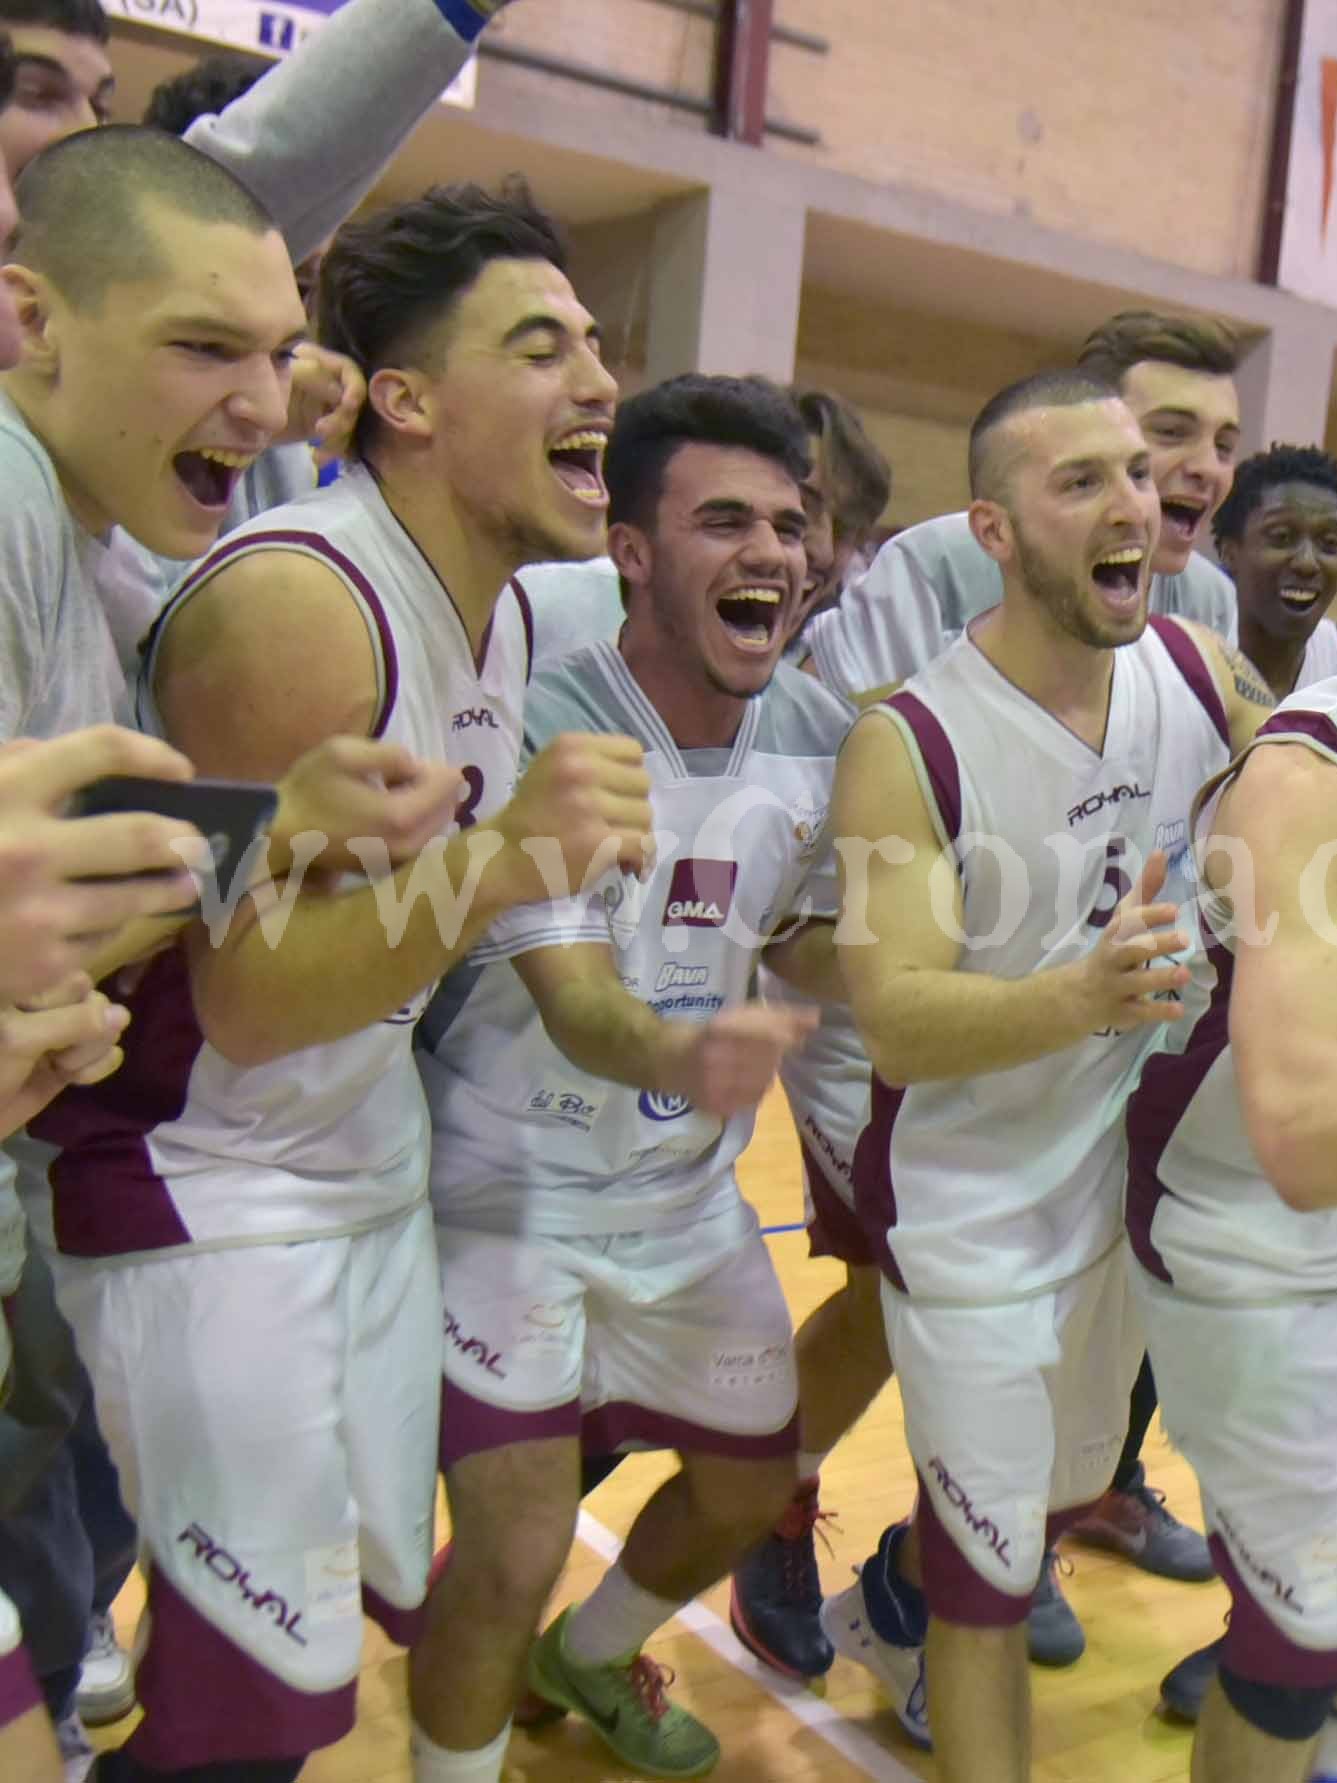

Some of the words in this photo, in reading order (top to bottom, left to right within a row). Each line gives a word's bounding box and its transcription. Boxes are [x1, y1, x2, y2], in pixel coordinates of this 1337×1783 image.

[451, 706, 500, 731] ROYAL
[1067, 783, 1152, 828] ROYAL
[443, 1306, 507, 1380] YAL
[928, 1457, 1011, 1571] ROYAL
[176, 1521, 308, 1648] ROYAL
